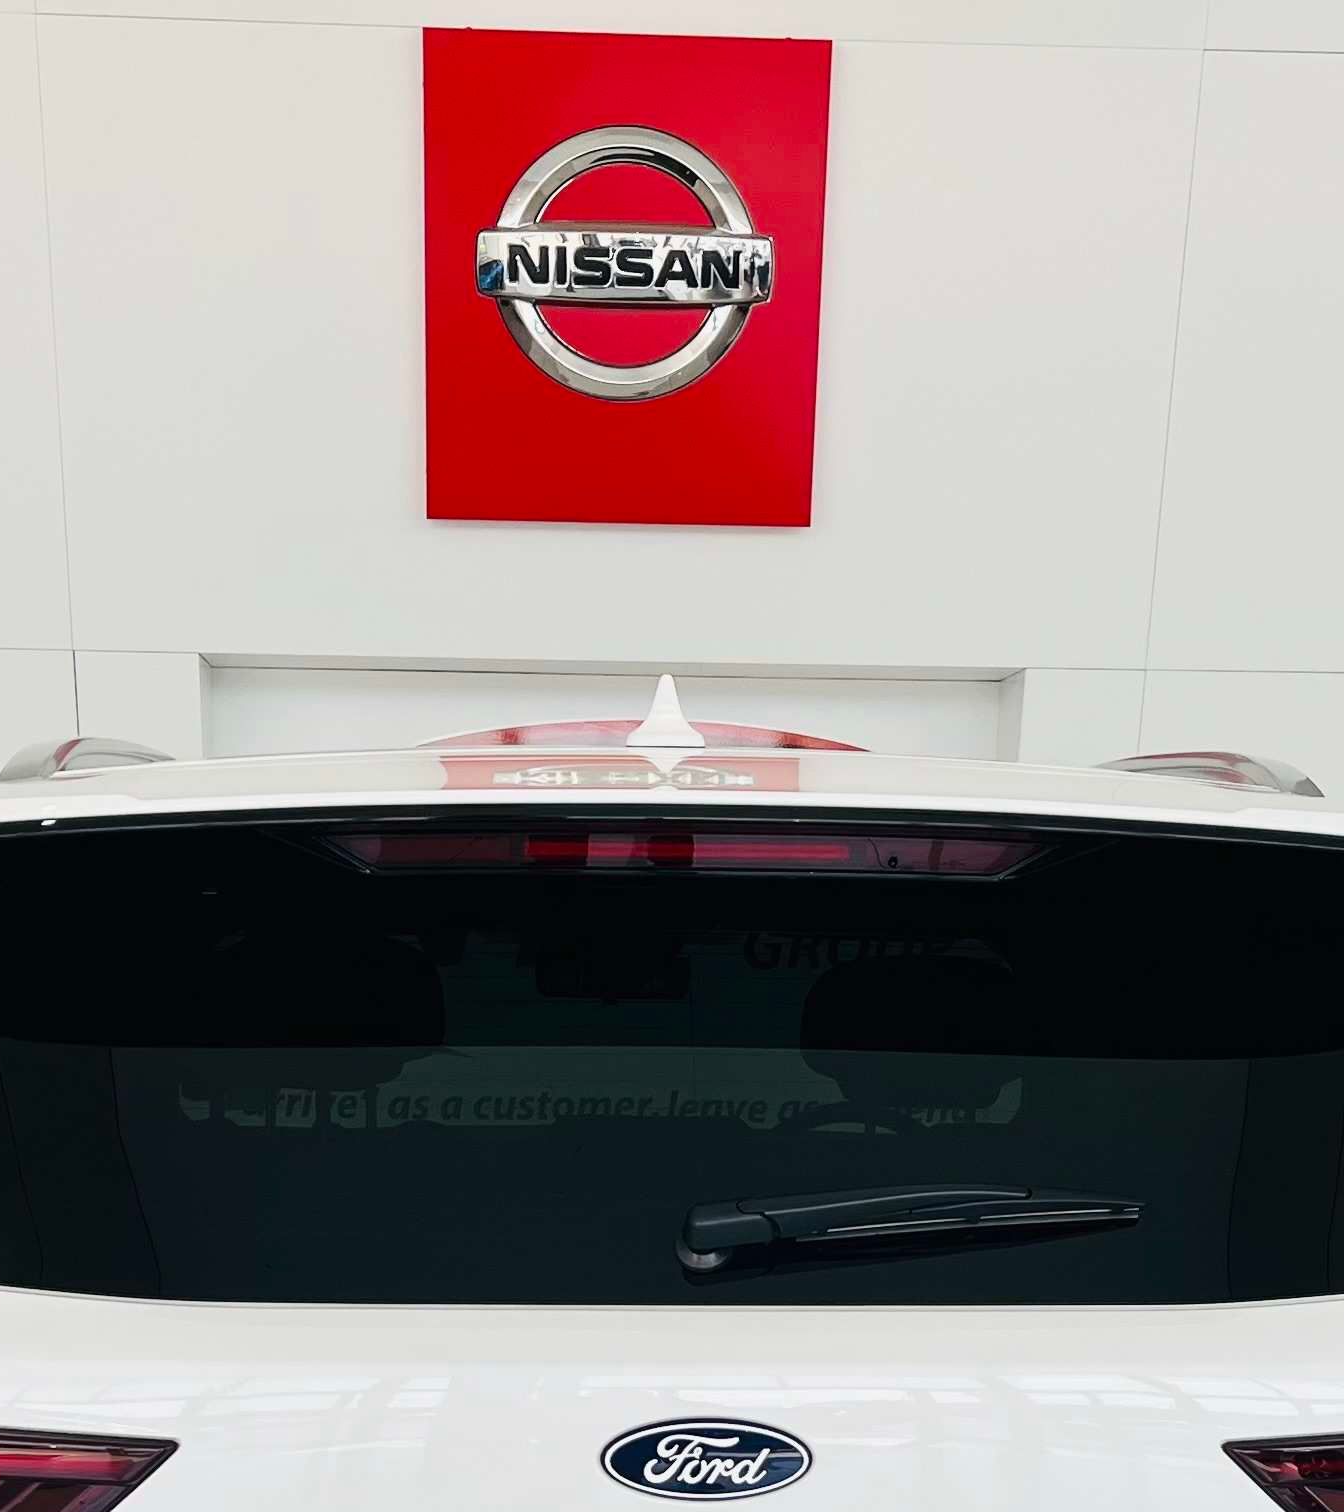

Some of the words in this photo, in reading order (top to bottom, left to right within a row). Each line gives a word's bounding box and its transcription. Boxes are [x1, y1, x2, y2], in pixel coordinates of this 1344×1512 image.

[506, 244, 742, 290] NISSAN
[387, 1095, 430, 1120] as
[440, 1095, 464, 1120] a
[643, 1434, 771, 1485] Ford
